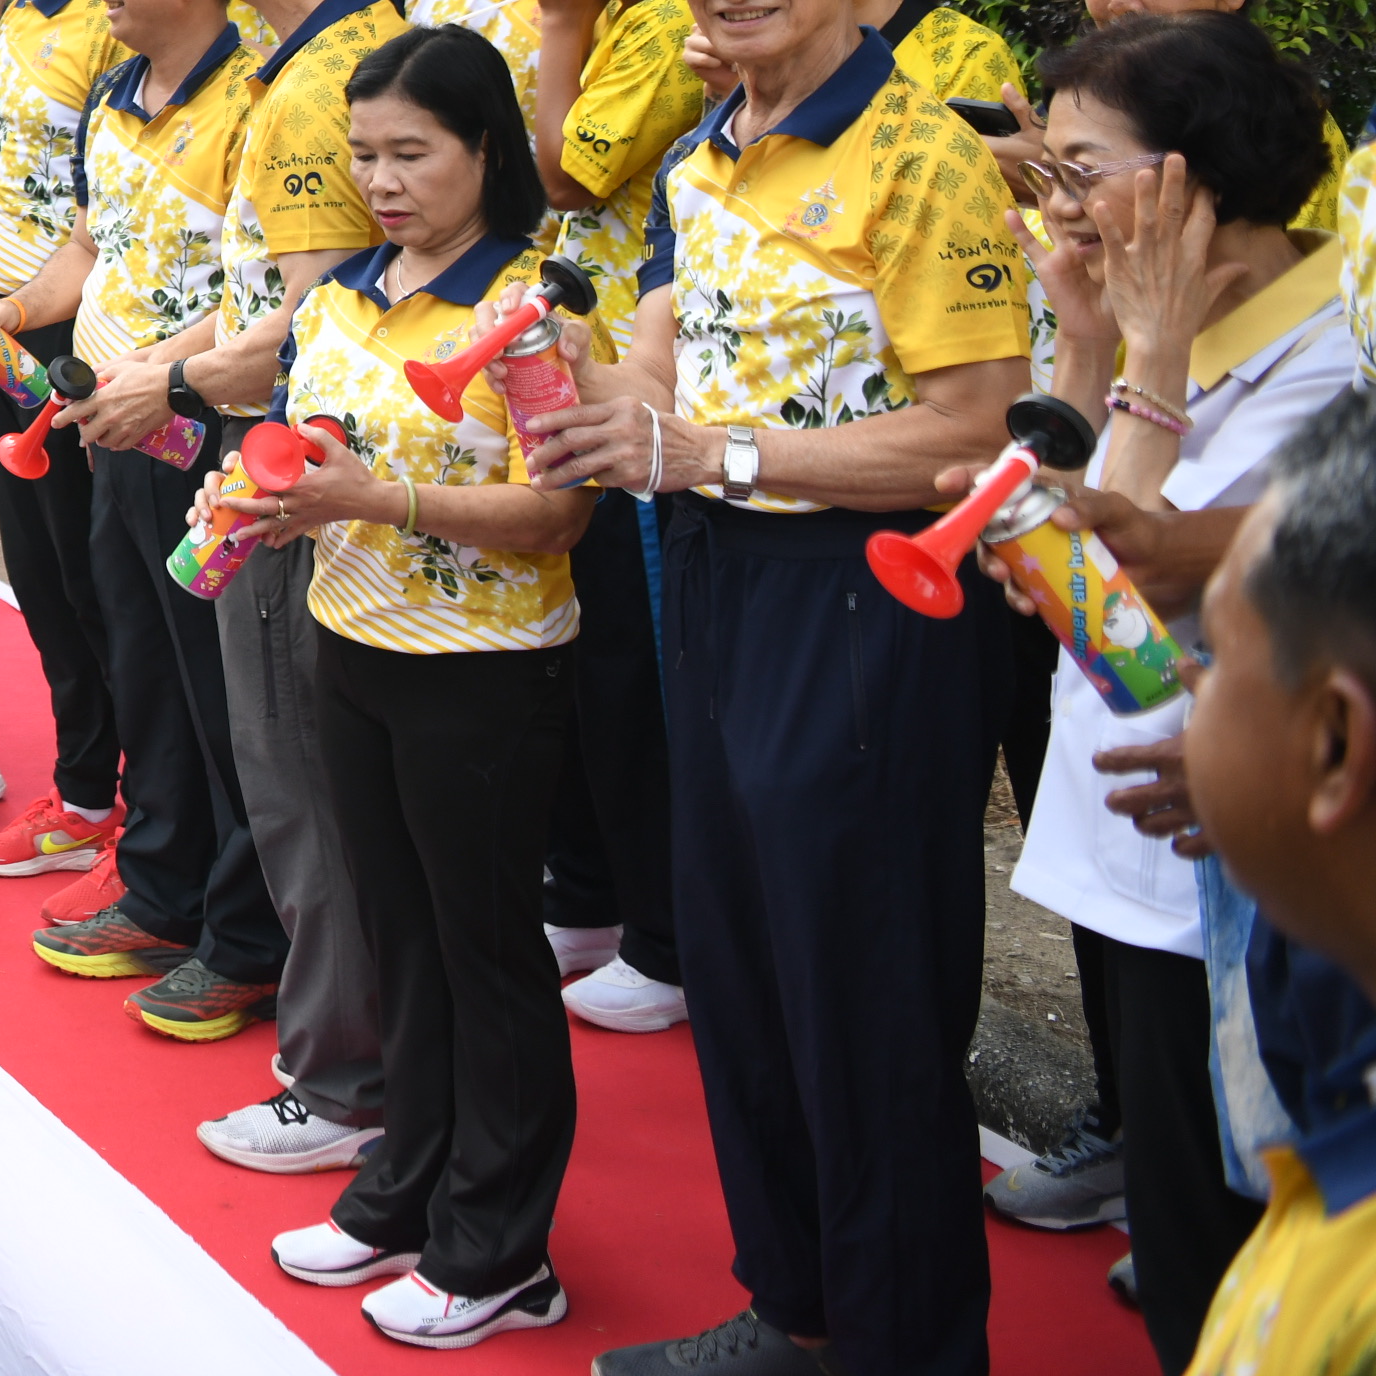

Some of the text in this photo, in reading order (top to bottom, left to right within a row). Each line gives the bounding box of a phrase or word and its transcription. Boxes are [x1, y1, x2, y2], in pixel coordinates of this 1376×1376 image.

[283, 171, 326, 197] ๑๐
[965, 263, 1013, 294] ๑
[1067, 530, 1092, 662] super air hor
